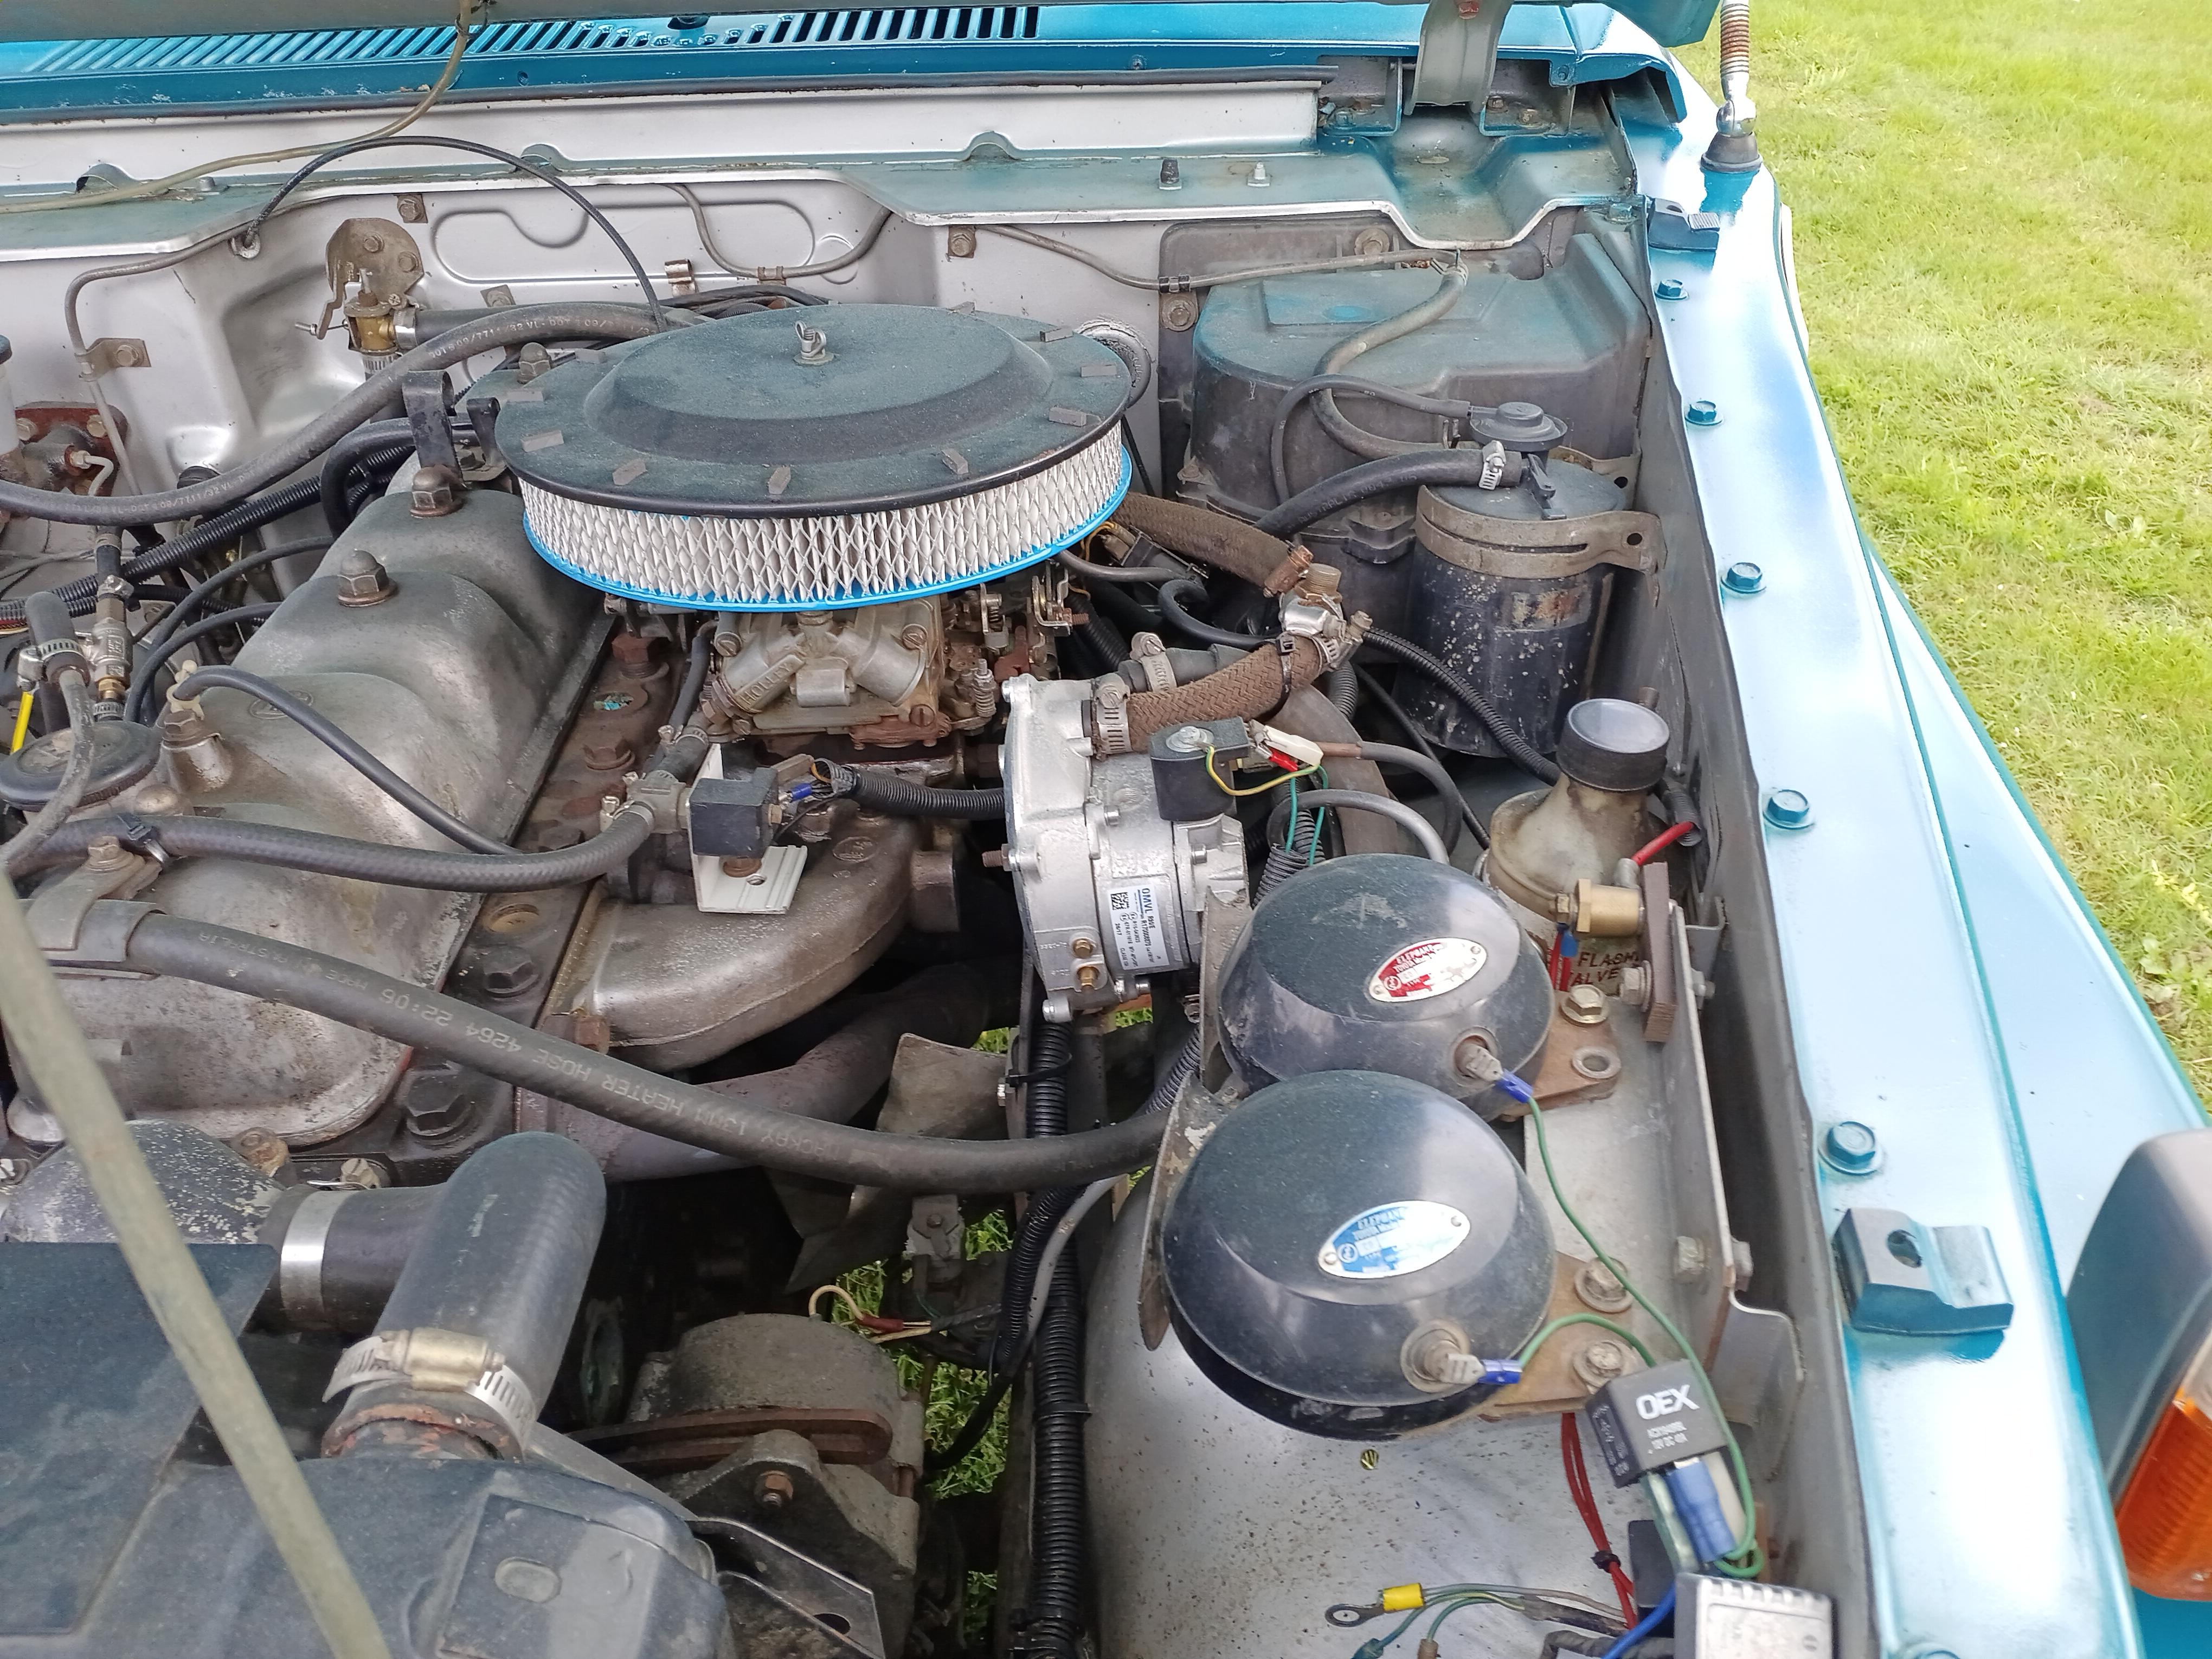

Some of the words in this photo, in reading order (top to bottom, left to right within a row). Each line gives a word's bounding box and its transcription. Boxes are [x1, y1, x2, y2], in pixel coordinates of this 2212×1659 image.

[1142, 888, 1153, 914] OMVL
[1570, 968, 1620, 987] ALVE
[380, 988, 454, 1027] 22:06
[466, 1023, 523, 1054] 4264
[532, 1047, 592, 1083] HOSE
[601, 1072, 686, 1117] HEATER
[1635, 1384, 1701, 1420] OEX
